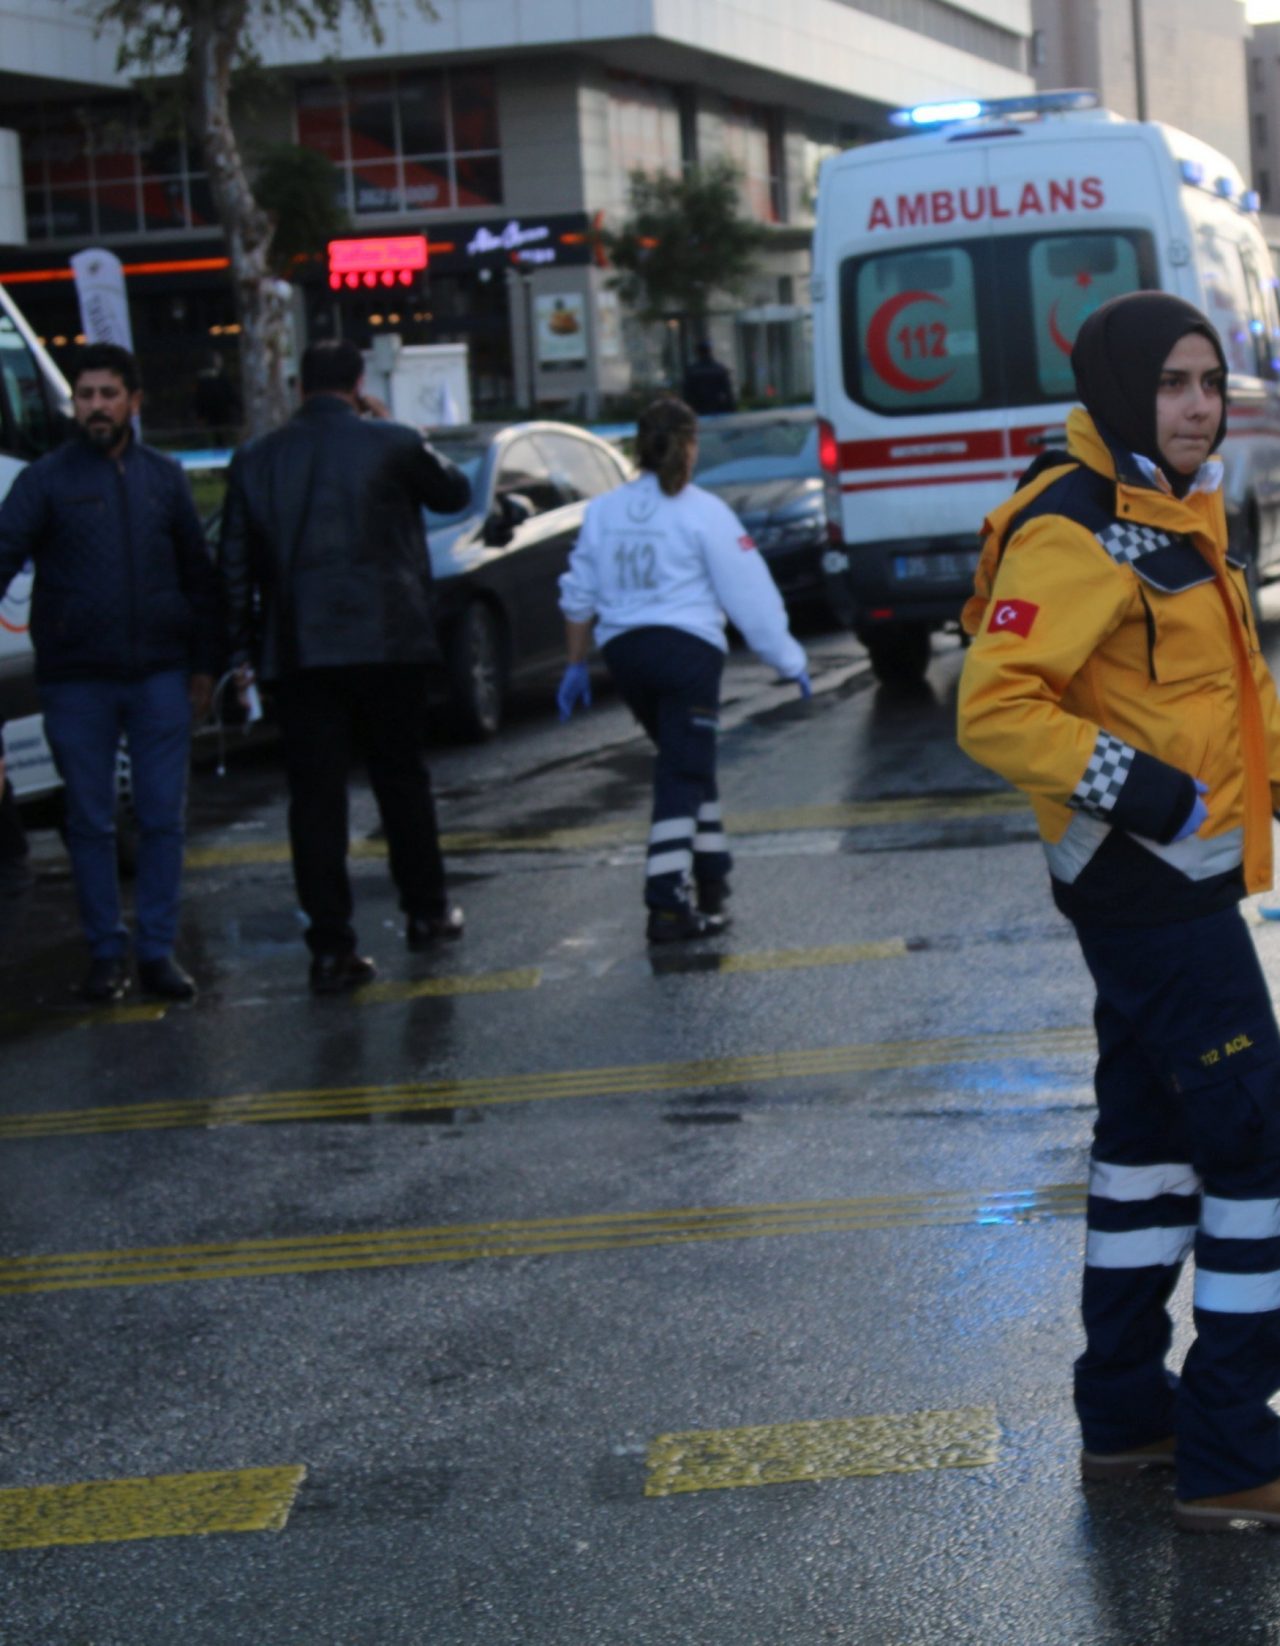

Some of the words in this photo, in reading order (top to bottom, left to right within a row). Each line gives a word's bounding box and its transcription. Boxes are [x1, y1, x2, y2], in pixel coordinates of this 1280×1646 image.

[866, 176, 1105, 232] AMBULANS
[896, 321, 948, 359] 112
[615, 542, 658, 590] 112
